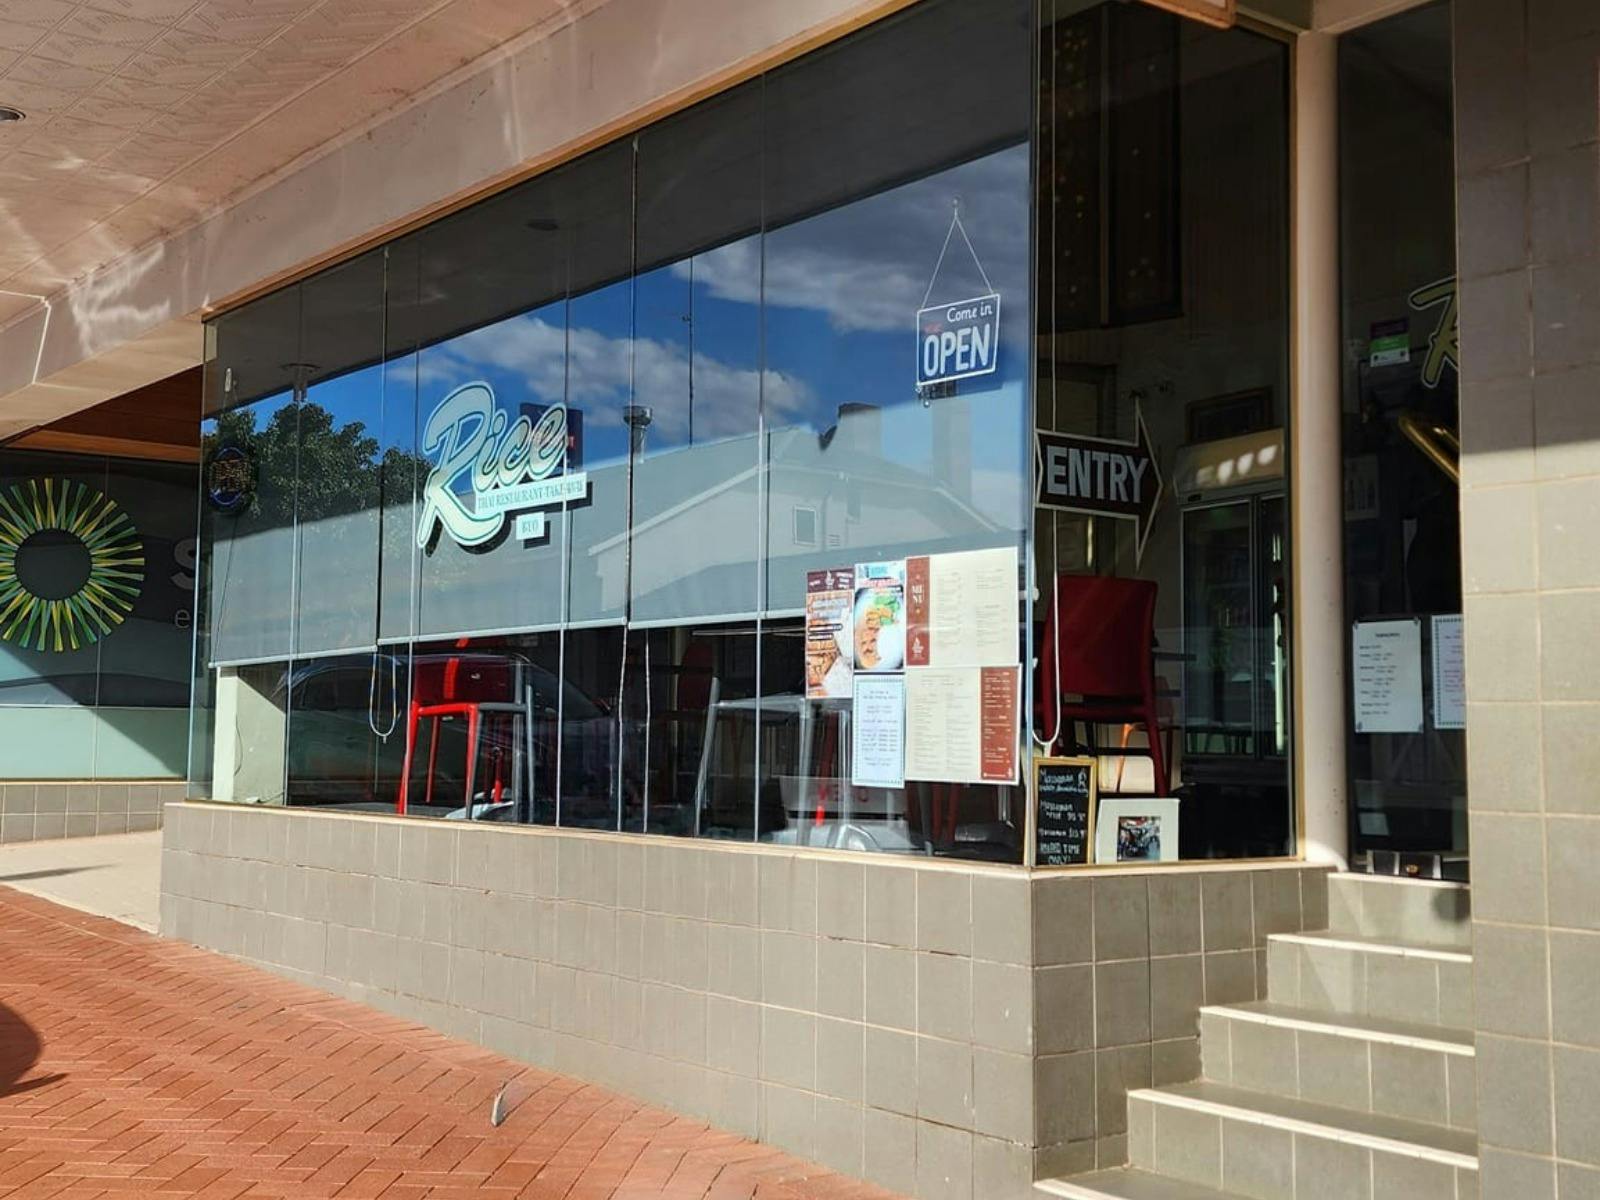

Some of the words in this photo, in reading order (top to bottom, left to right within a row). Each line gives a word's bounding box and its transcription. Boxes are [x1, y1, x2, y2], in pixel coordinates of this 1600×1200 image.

[946, 307, 978, 323] Come
[980, 301, 993, 316] in
[923, 323, 991, 377] OPEN
[417, 380, 568, 548] Rice
[1046, 444, 1150, 504] ENTRY
